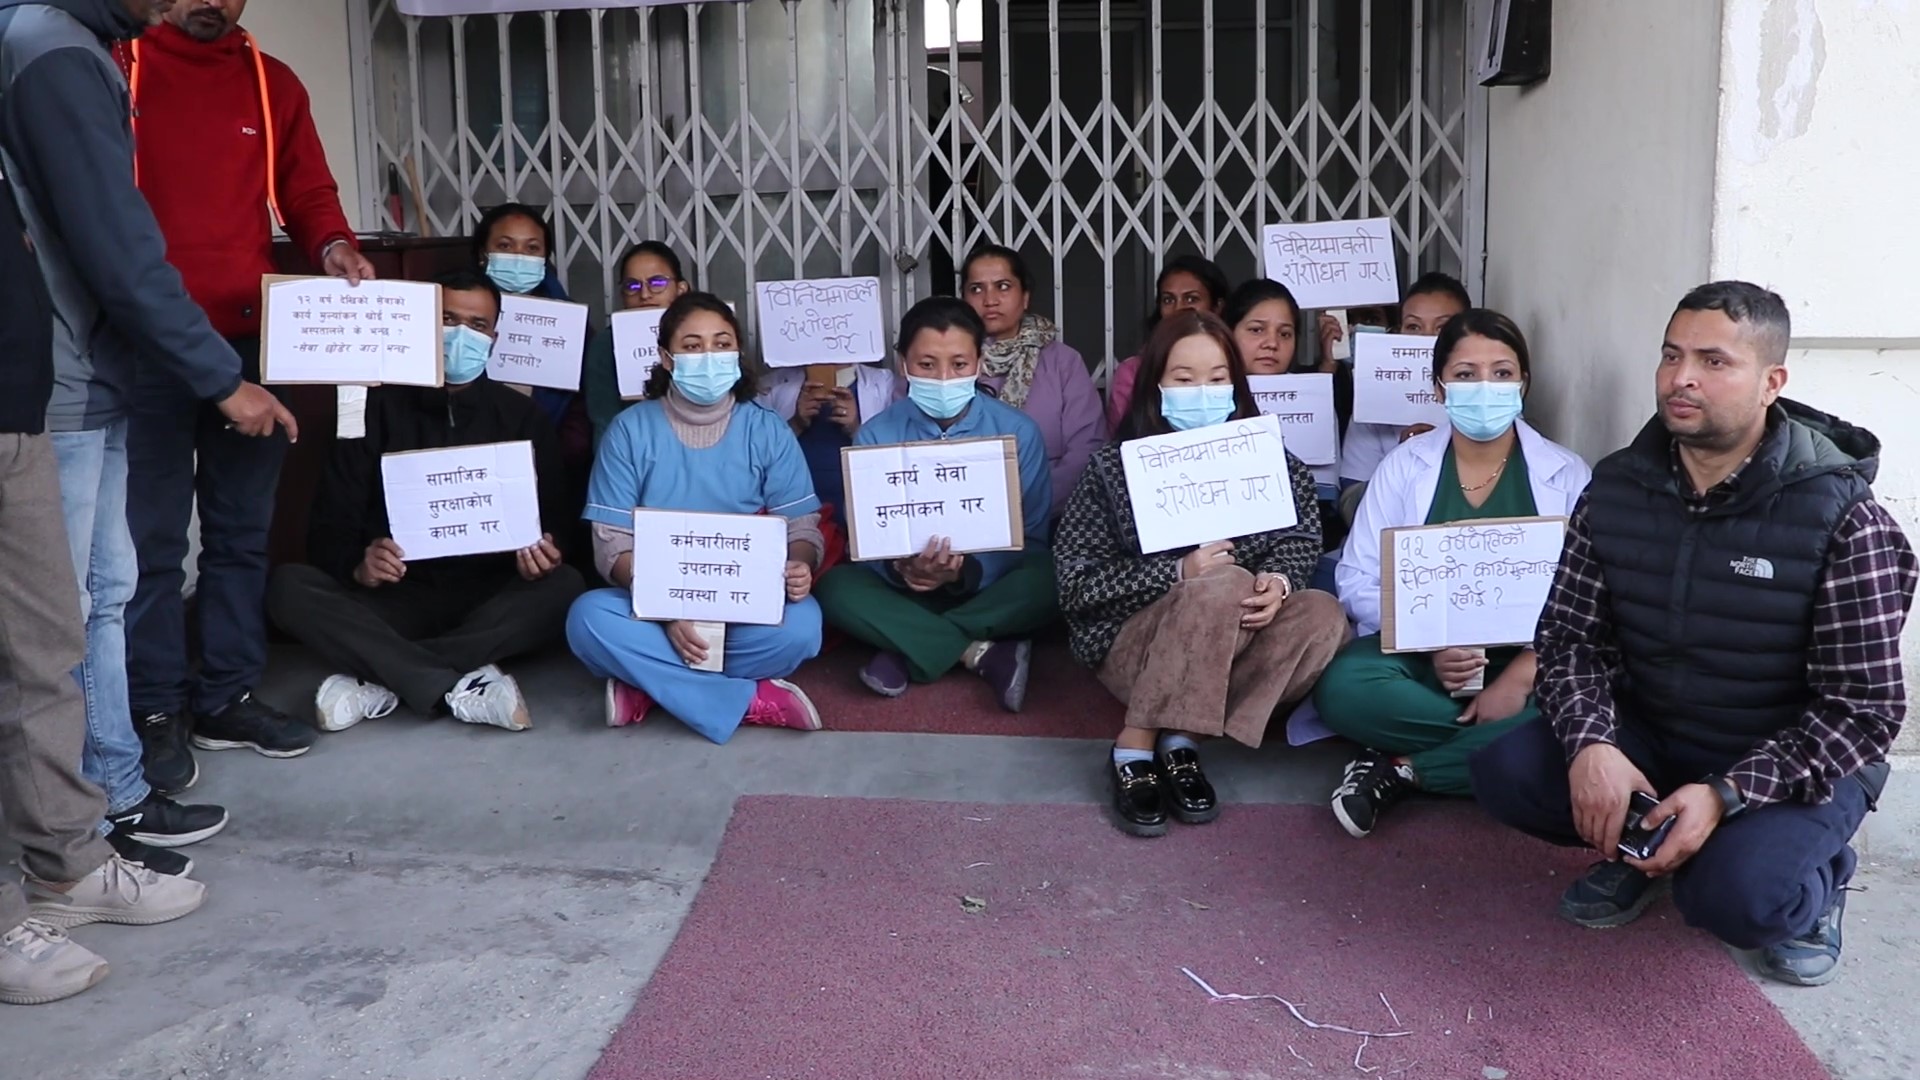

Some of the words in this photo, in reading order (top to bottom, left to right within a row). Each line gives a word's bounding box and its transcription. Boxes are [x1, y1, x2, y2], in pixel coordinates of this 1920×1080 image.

[297, 295, 311, 305] १२
[376, 295, 406, 306] सेवाको
[292, 309, 312, 320] कार्य
[514, 312, 558, 327] अस्पताल
[301, 324, 345, 335] अस्पतालले
[353, 325, 362, 335] के
[508, 332, 533, 345] सम्म
[541, 336, 567, 349] कस्ले
[1374, 366, 1413, 381] सेवाको
[1137, 424, 1268, 473] विनियमावली
[426, 465, 488, 486] सामाजिक
[885, 464, 920, 486] कार्य
[934, 462, 968, 483] सेवा
[428, 492, 493, 519] सुरक्षाकोष
[875, 499, 945, 528] मुल्यांकन
[959, 497, 985, 514] गर
[429, 523, 468, 539] कायम
[480, 520, 501, 534] गर
[670, 531, 751, 552] कर्मचारीलाई
[678, 560, 742, 578] उपदानको
[668, 588, 718, 603] व्यवस्था
[729, 591, 750, 605] गर
